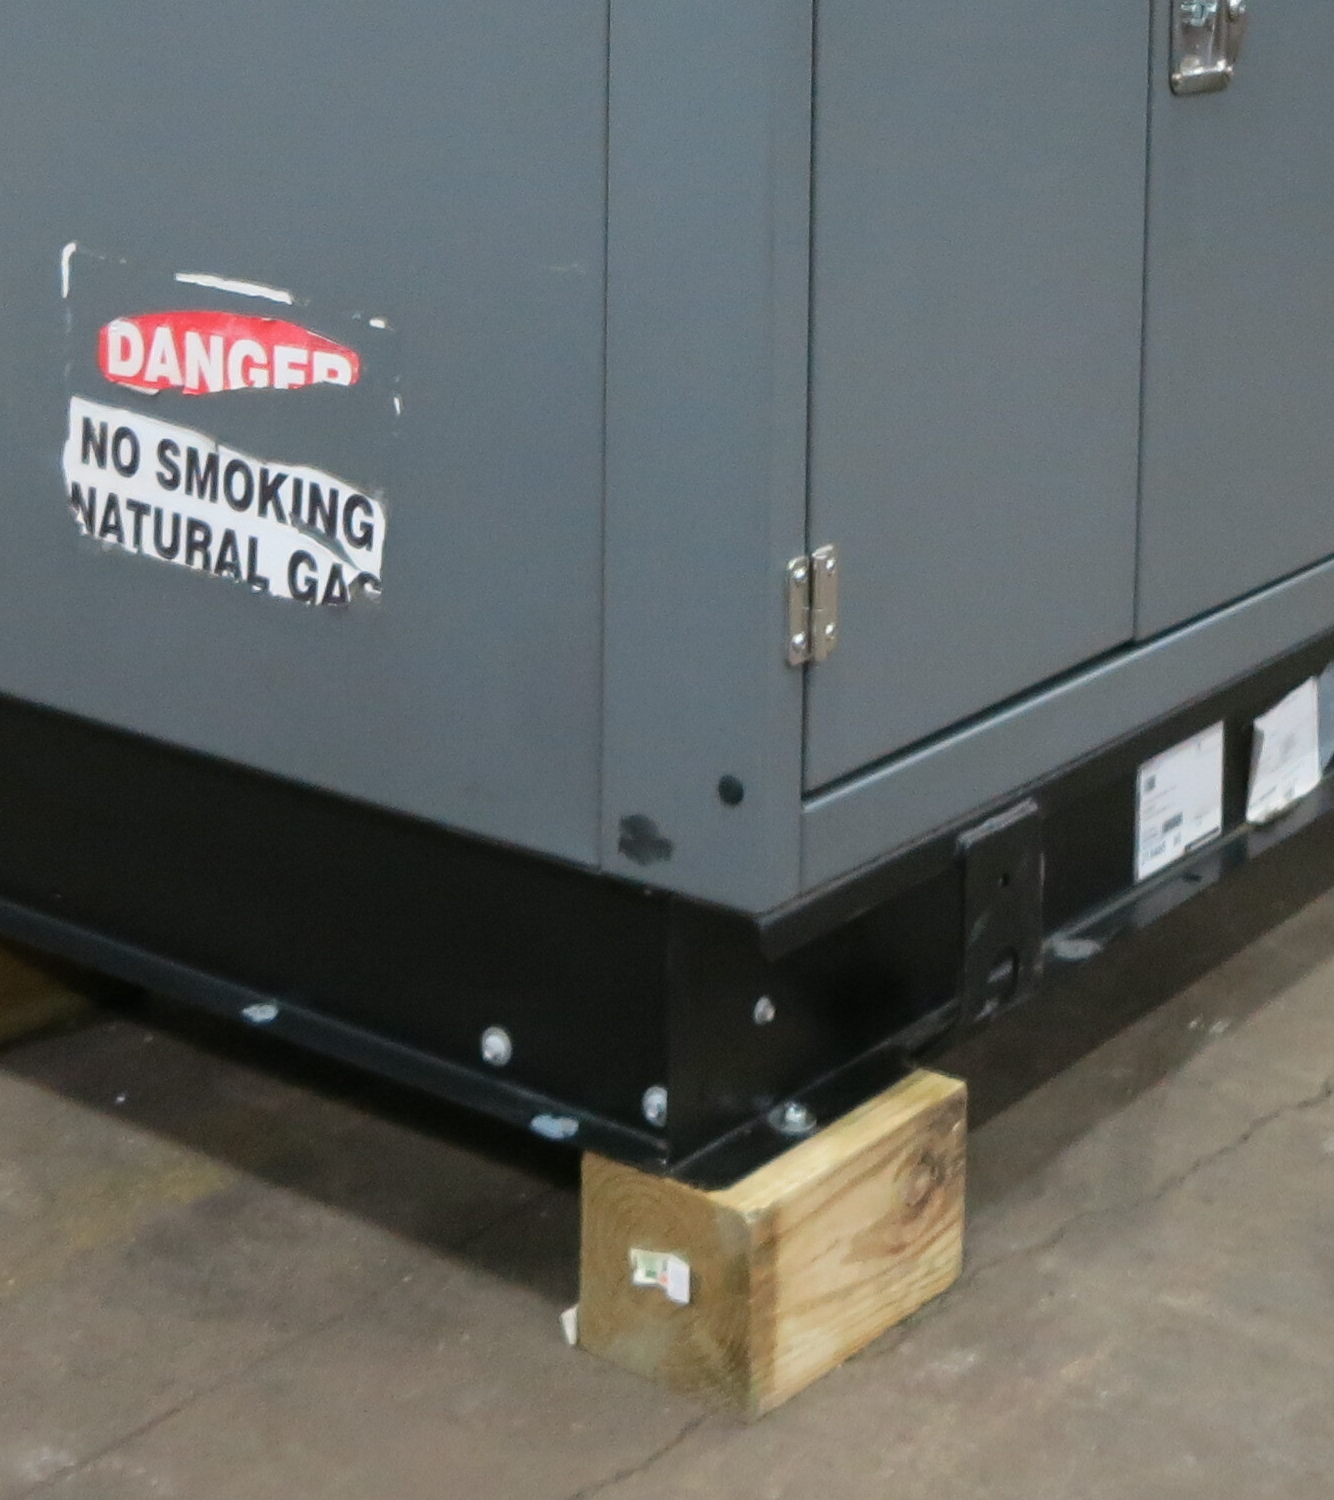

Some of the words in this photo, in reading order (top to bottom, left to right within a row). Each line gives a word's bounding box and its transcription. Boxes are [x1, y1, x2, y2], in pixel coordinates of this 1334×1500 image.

[71, 481, 270, 586] NATURAL
[81, 416, 141, 478] NO
[155, 438, 375, 552] SMOKING
